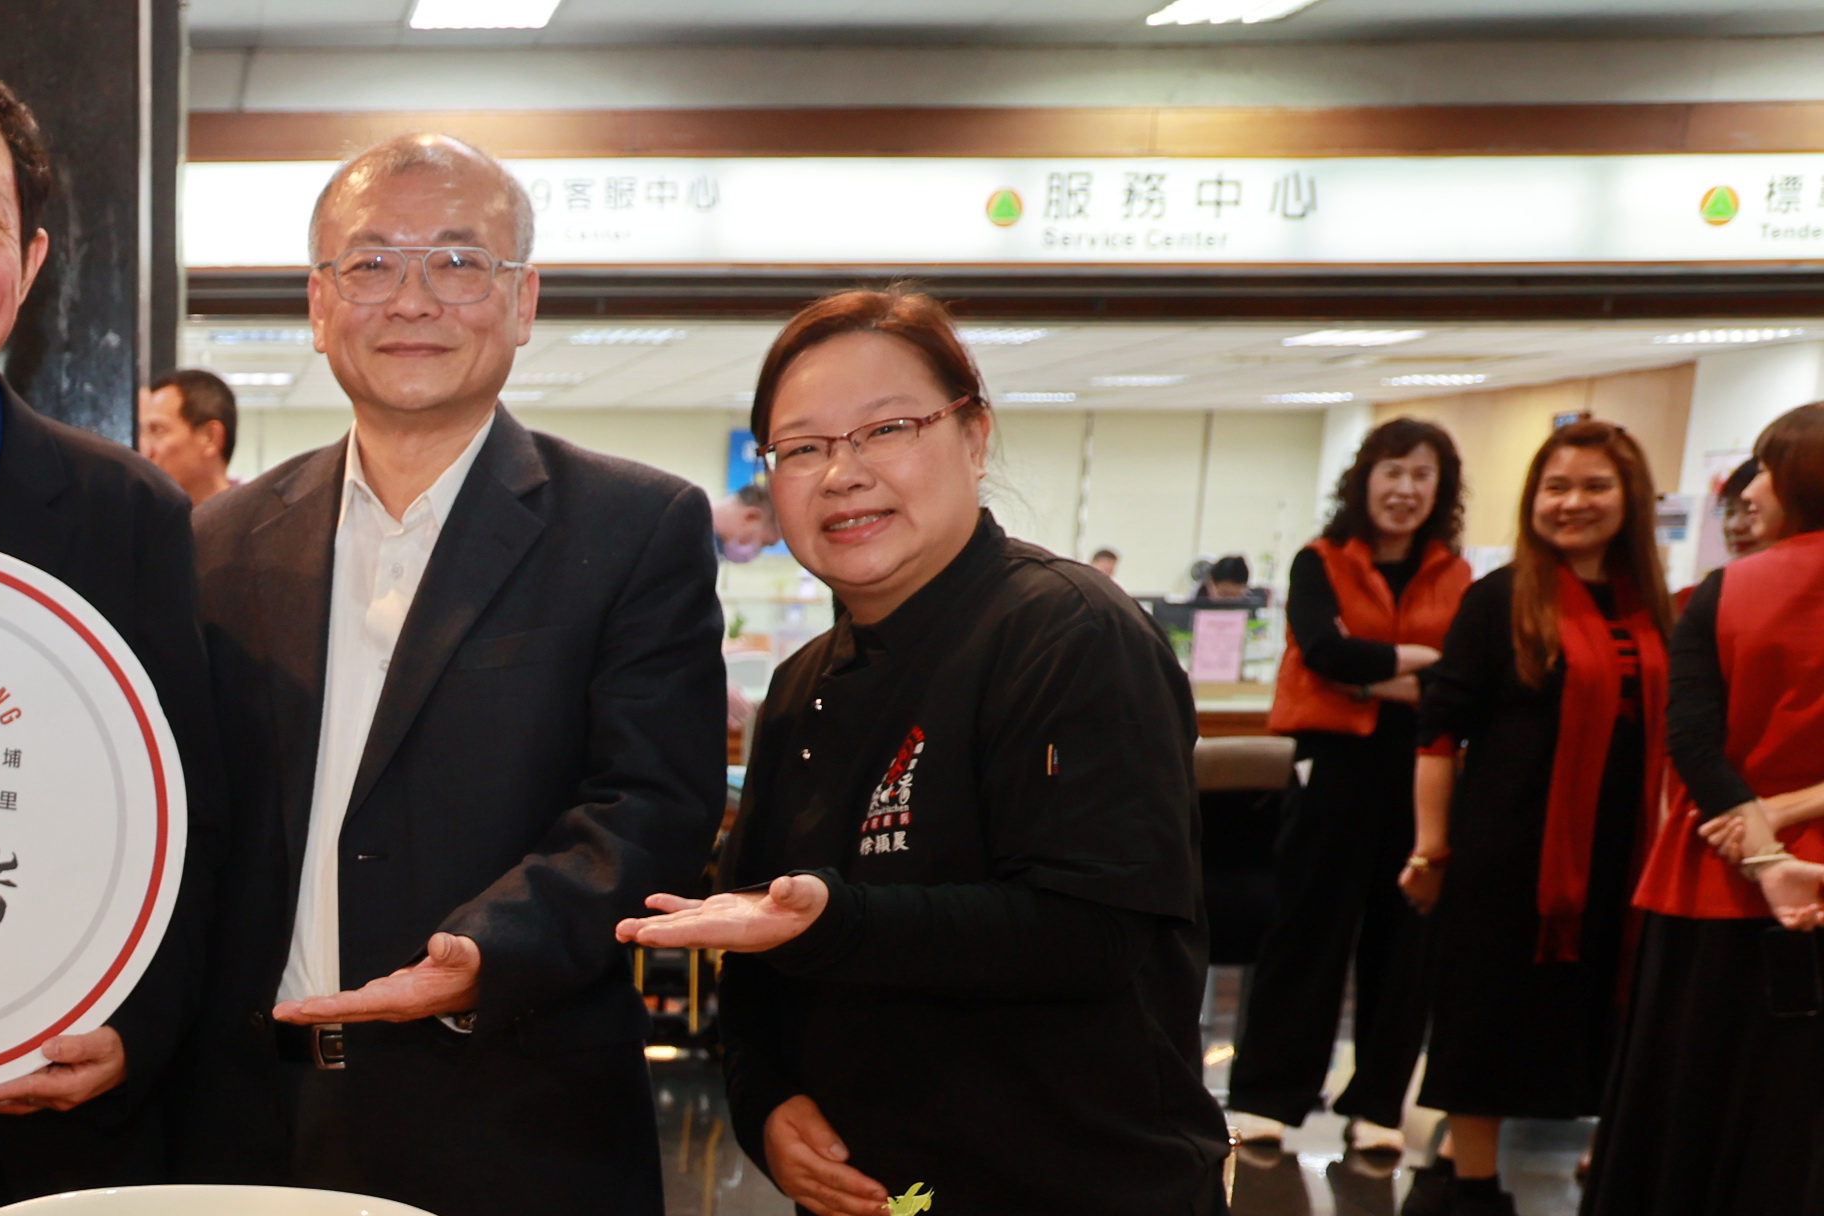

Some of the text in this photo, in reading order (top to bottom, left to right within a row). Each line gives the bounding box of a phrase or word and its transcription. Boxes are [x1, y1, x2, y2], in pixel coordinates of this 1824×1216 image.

[1044, 170, 1318, 220] 服務中心
[1042, 226, 1229, 248] Service Center
